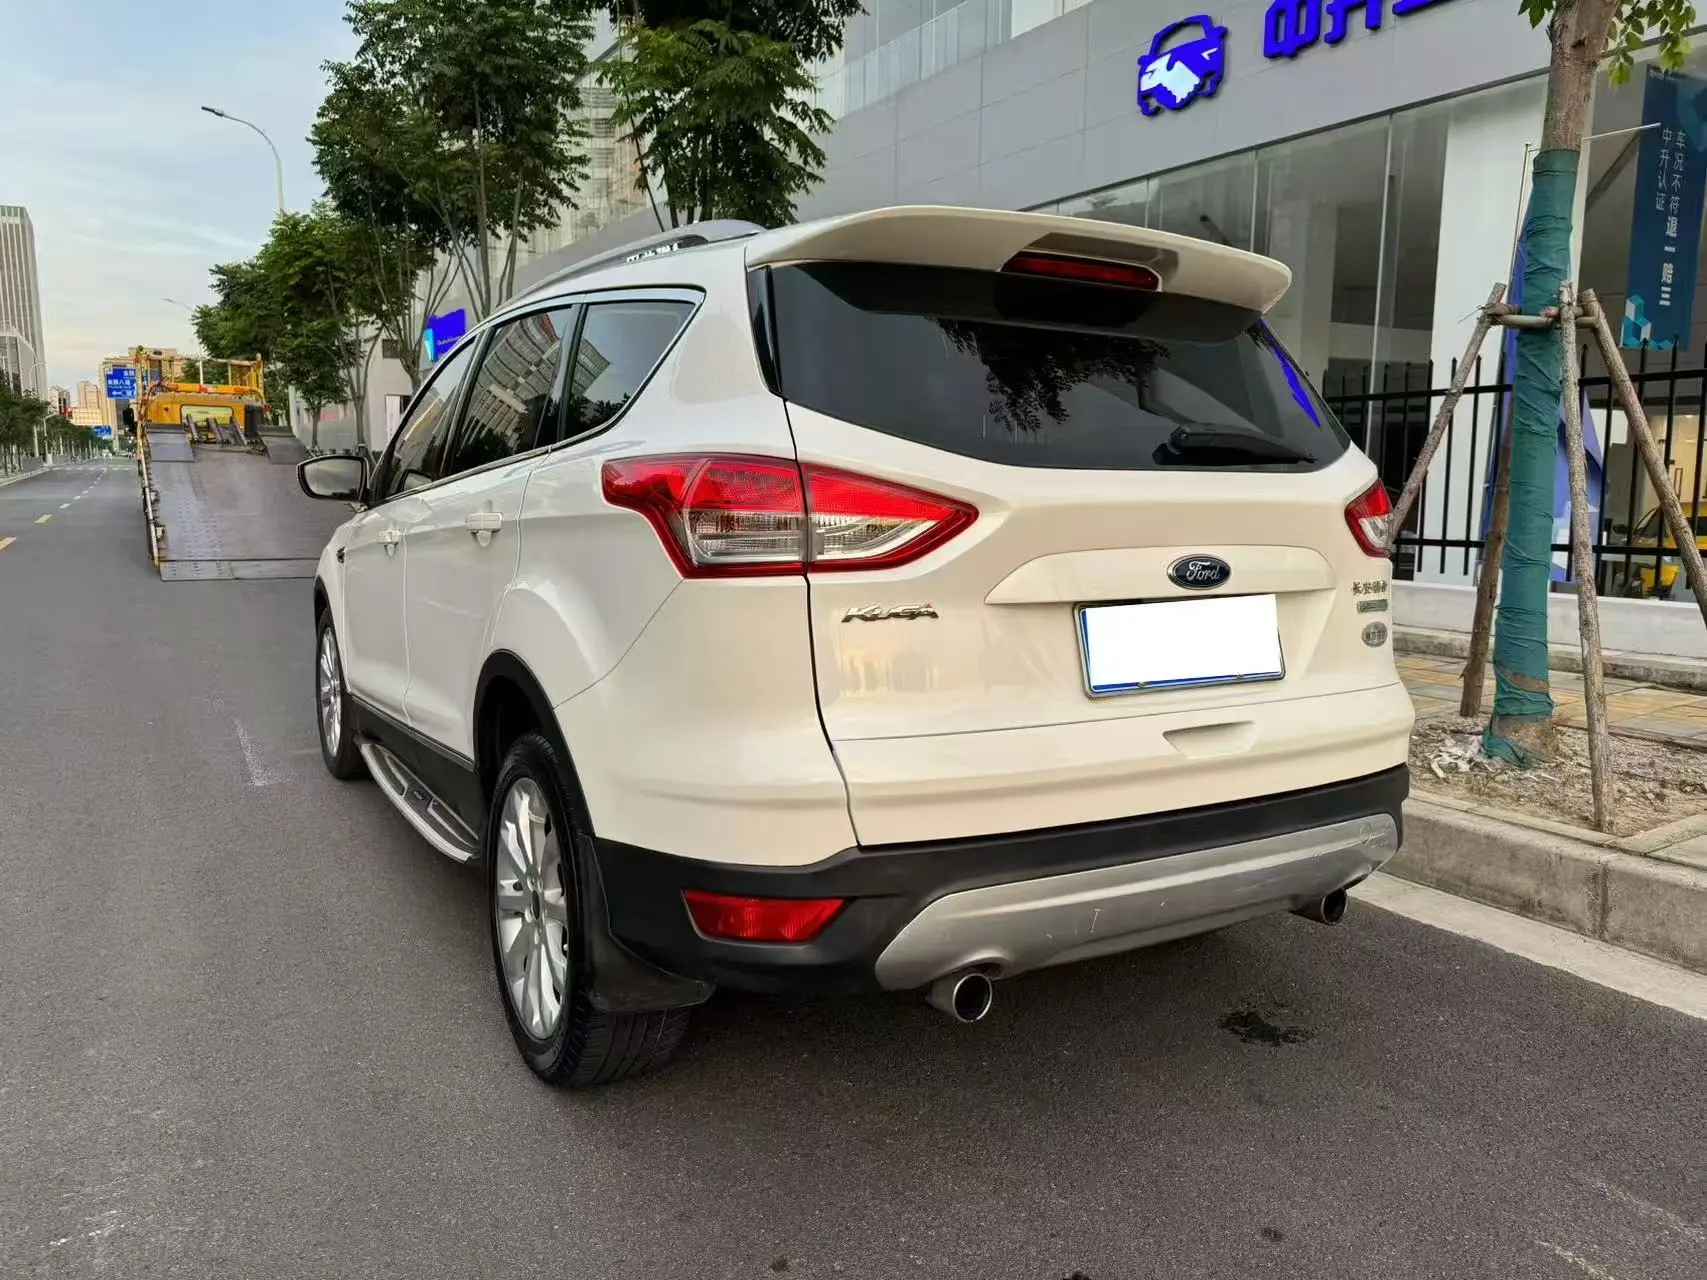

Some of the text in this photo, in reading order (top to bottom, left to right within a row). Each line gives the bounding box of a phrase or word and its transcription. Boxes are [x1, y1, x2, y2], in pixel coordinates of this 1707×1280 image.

[1655, 127, 1671, 211] 中升认证
[1659, 129, 1686, 306] 车况不符退一赔三
[1186, 560, 1221, 580] Ford
